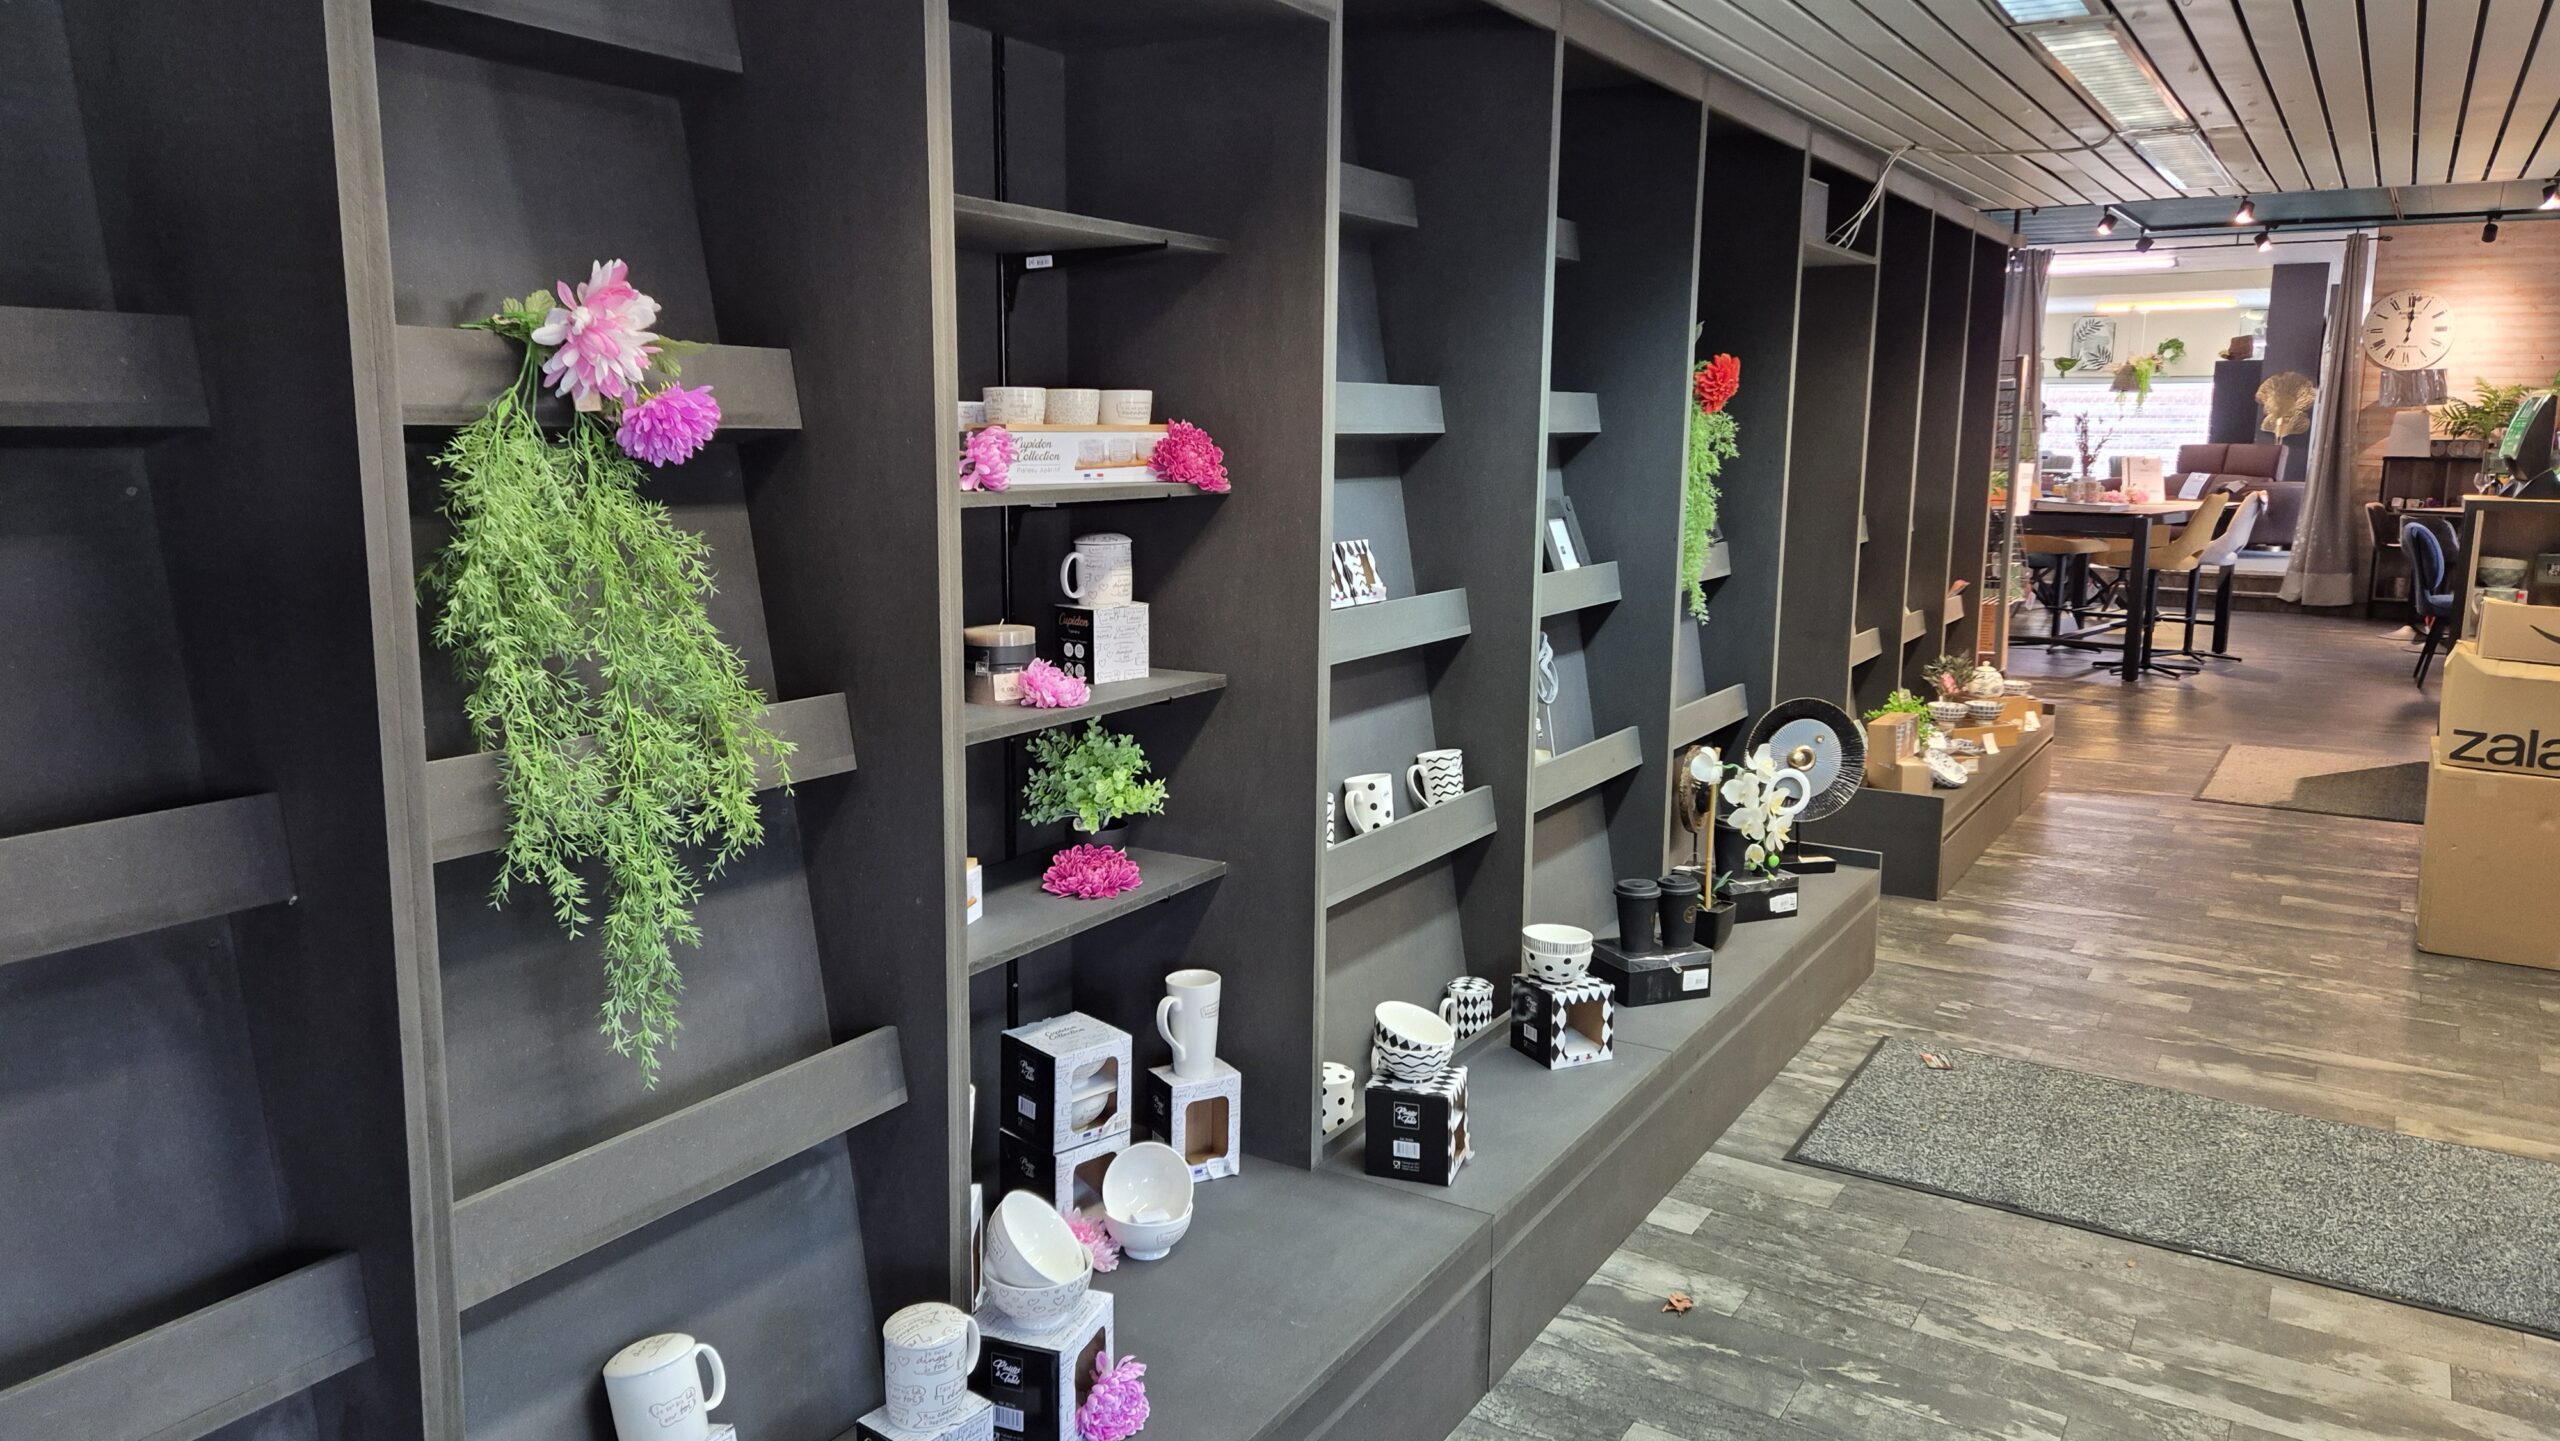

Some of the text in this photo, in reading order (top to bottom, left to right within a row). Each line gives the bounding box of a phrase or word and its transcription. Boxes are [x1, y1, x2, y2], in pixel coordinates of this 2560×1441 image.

[1013, 437, 1052, 452] Cupidon
[1016, 449, 1060, 463] Collection
[1059, 612, 1090, 627] Cupidon
